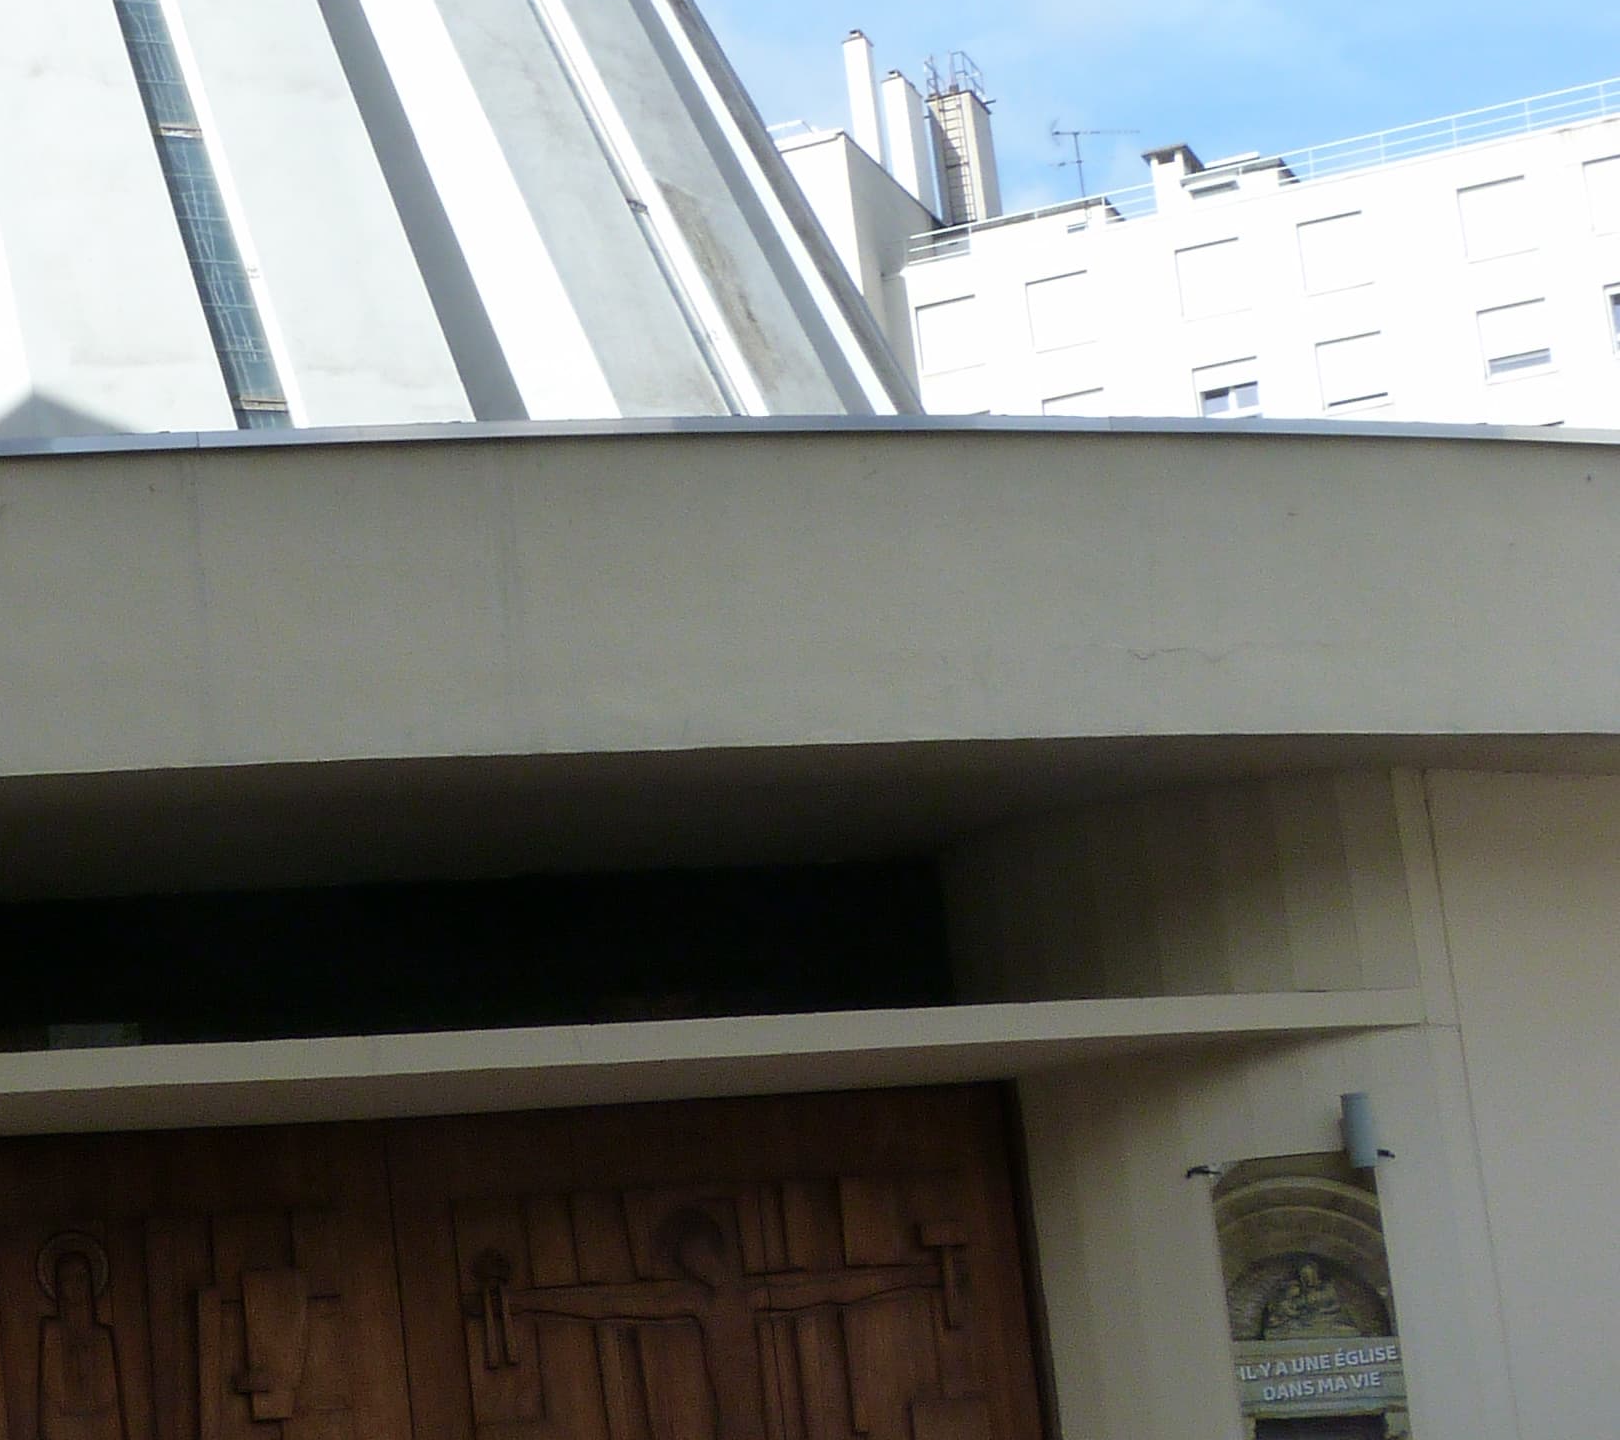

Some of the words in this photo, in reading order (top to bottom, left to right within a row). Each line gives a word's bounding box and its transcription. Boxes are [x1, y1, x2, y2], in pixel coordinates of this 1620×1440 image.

[1240, 1366, 1257, 1380] IL
[1259, 1362, 1271, 1377] Y
[1276, 1362, 1289, 1376] A
[1291, 1354, 1331, 1373] UNE
[1334, 1345, 1398, 1367] ÉGLISE
[1263, 1379, 1315, 1401] DANS
[1318, 1376, 1348, 1393] MA
[1350, 1371, 1382, 1388] VIE
